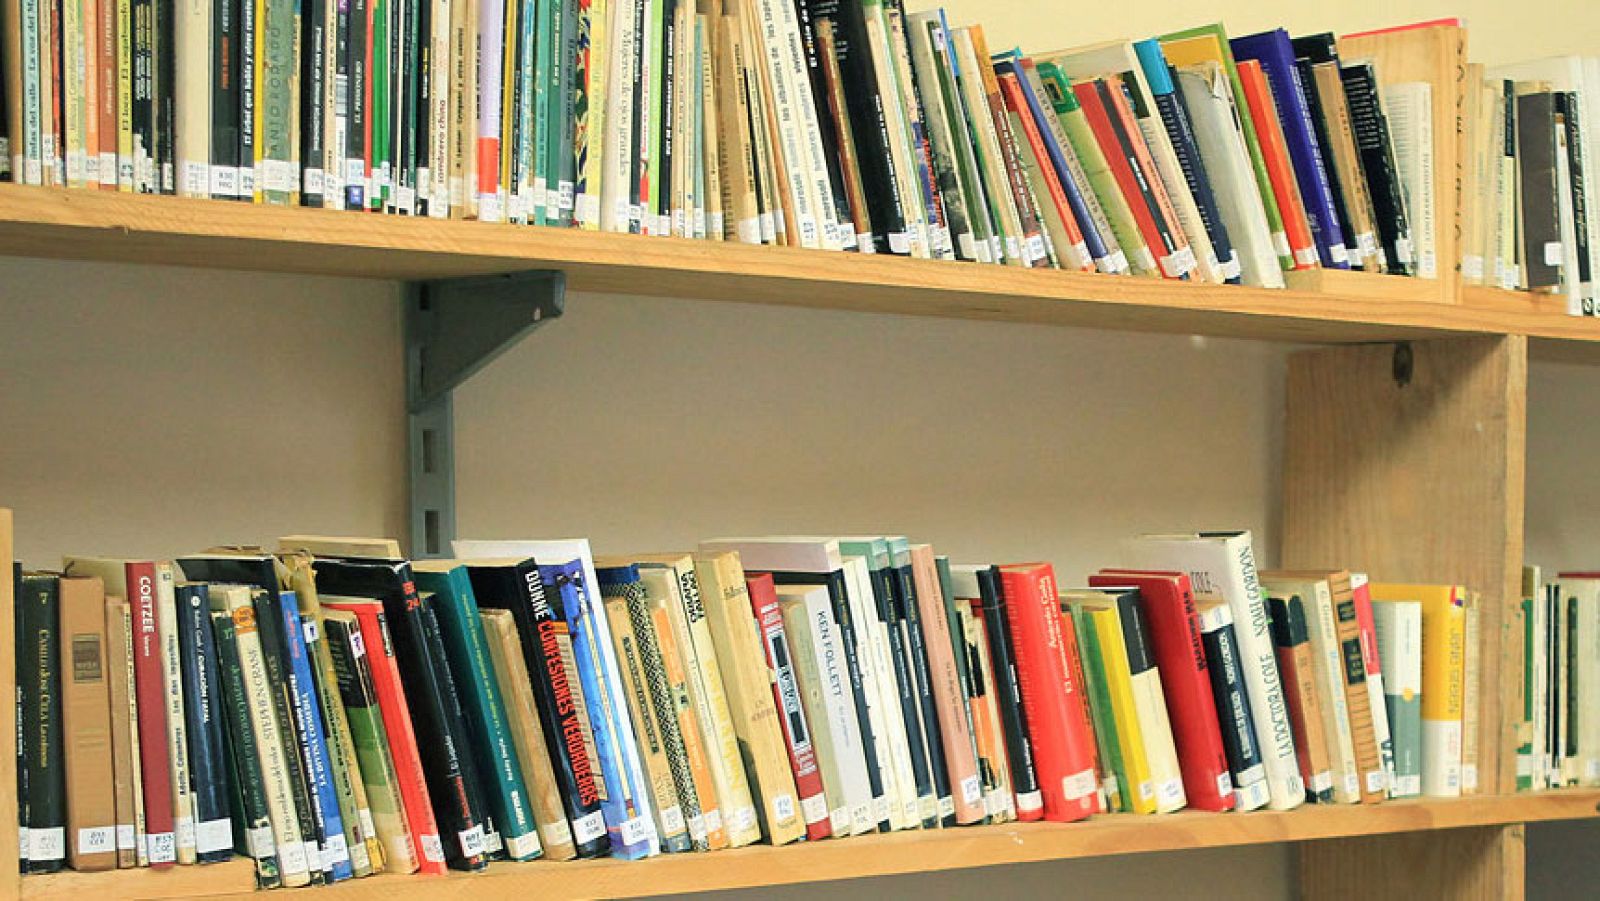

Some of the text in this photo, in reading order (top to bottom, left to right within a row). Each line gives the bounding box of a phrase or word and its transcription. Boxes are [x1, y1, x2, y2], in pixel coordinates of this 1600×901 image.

[622, 28, 632, 80] Mujeres
[621, 82, 630, 95] de
[437, 99, 446, 183] sombrero chino
[1036, 575, 1052, 604] Gala
[1238, 544, 1258, 597] GORDON
[138, 575, 155, 634] COETZEE
[816, 610, 842, 698] KEN FOLLETT
[1258, 651, 1278, 684] COLE
[524, 568, 599, 808] DUNNE CONFESIONES VERDADERAS
[1265, 684, 1291, 743] DOCTORA
